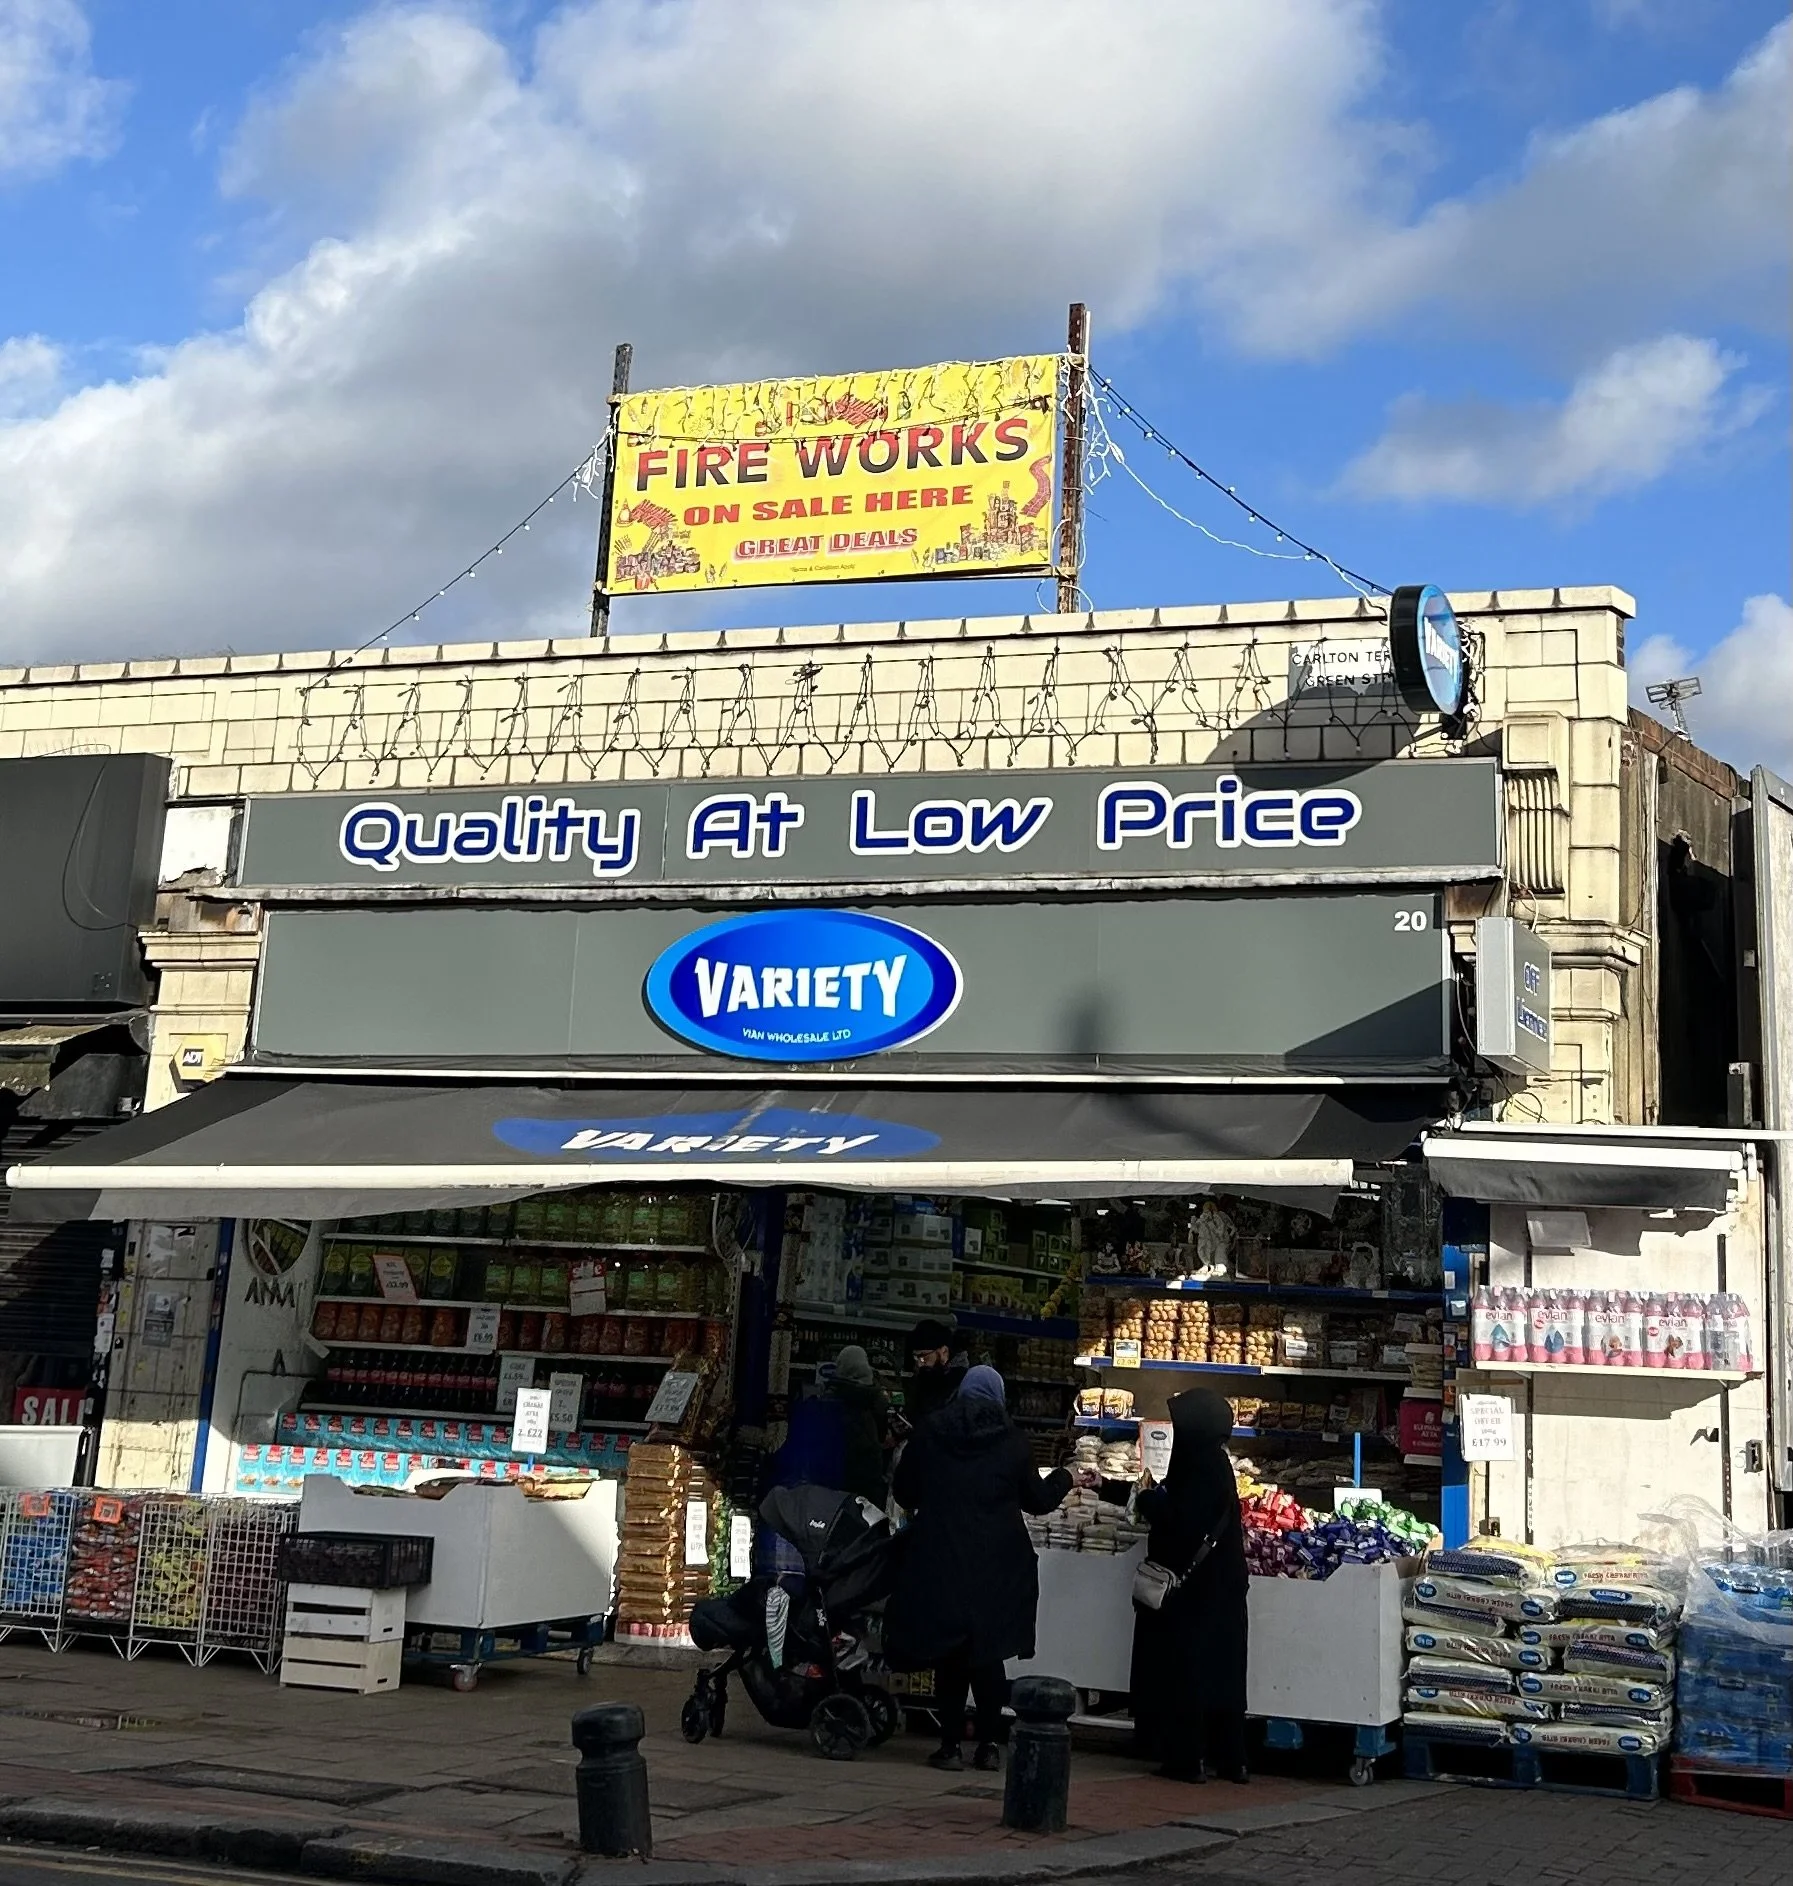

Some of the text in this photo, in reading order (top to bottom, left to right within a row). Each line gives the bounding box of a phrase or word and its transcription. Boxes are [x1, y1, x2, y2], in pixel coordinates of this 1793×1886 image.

[636, 416, 1030, 492] FIRE WORKS
[684, 484, 974, 526] ON SALE HERE
[737, 527, 919, 558] GREAT DEALS
[1291, 651, 1360, 666] CARLTON
[1304, 674, 1356, 688] GREEN
[341, 776, 1361, 876] Quality At Low Price
[1394, 910, 1428, 932] 20
[694, 954, 908, 1019] VARIETY
[742, 1027, 852, 1044] VIAN WHOLESALE LTD
[560, 1129, 881, 1156] VARIETY
[1485, 1310, 1513, 1322] evian
[1537, 1310, 1568, 1322] evian
[1595, 1313, 1625, 1324] evian
[1658, 1316, 1689, 1328] evian
[1470, 1406, 1505, 1415] SPECIAL
[1471, 1437, 1507, 1448] £17.99
